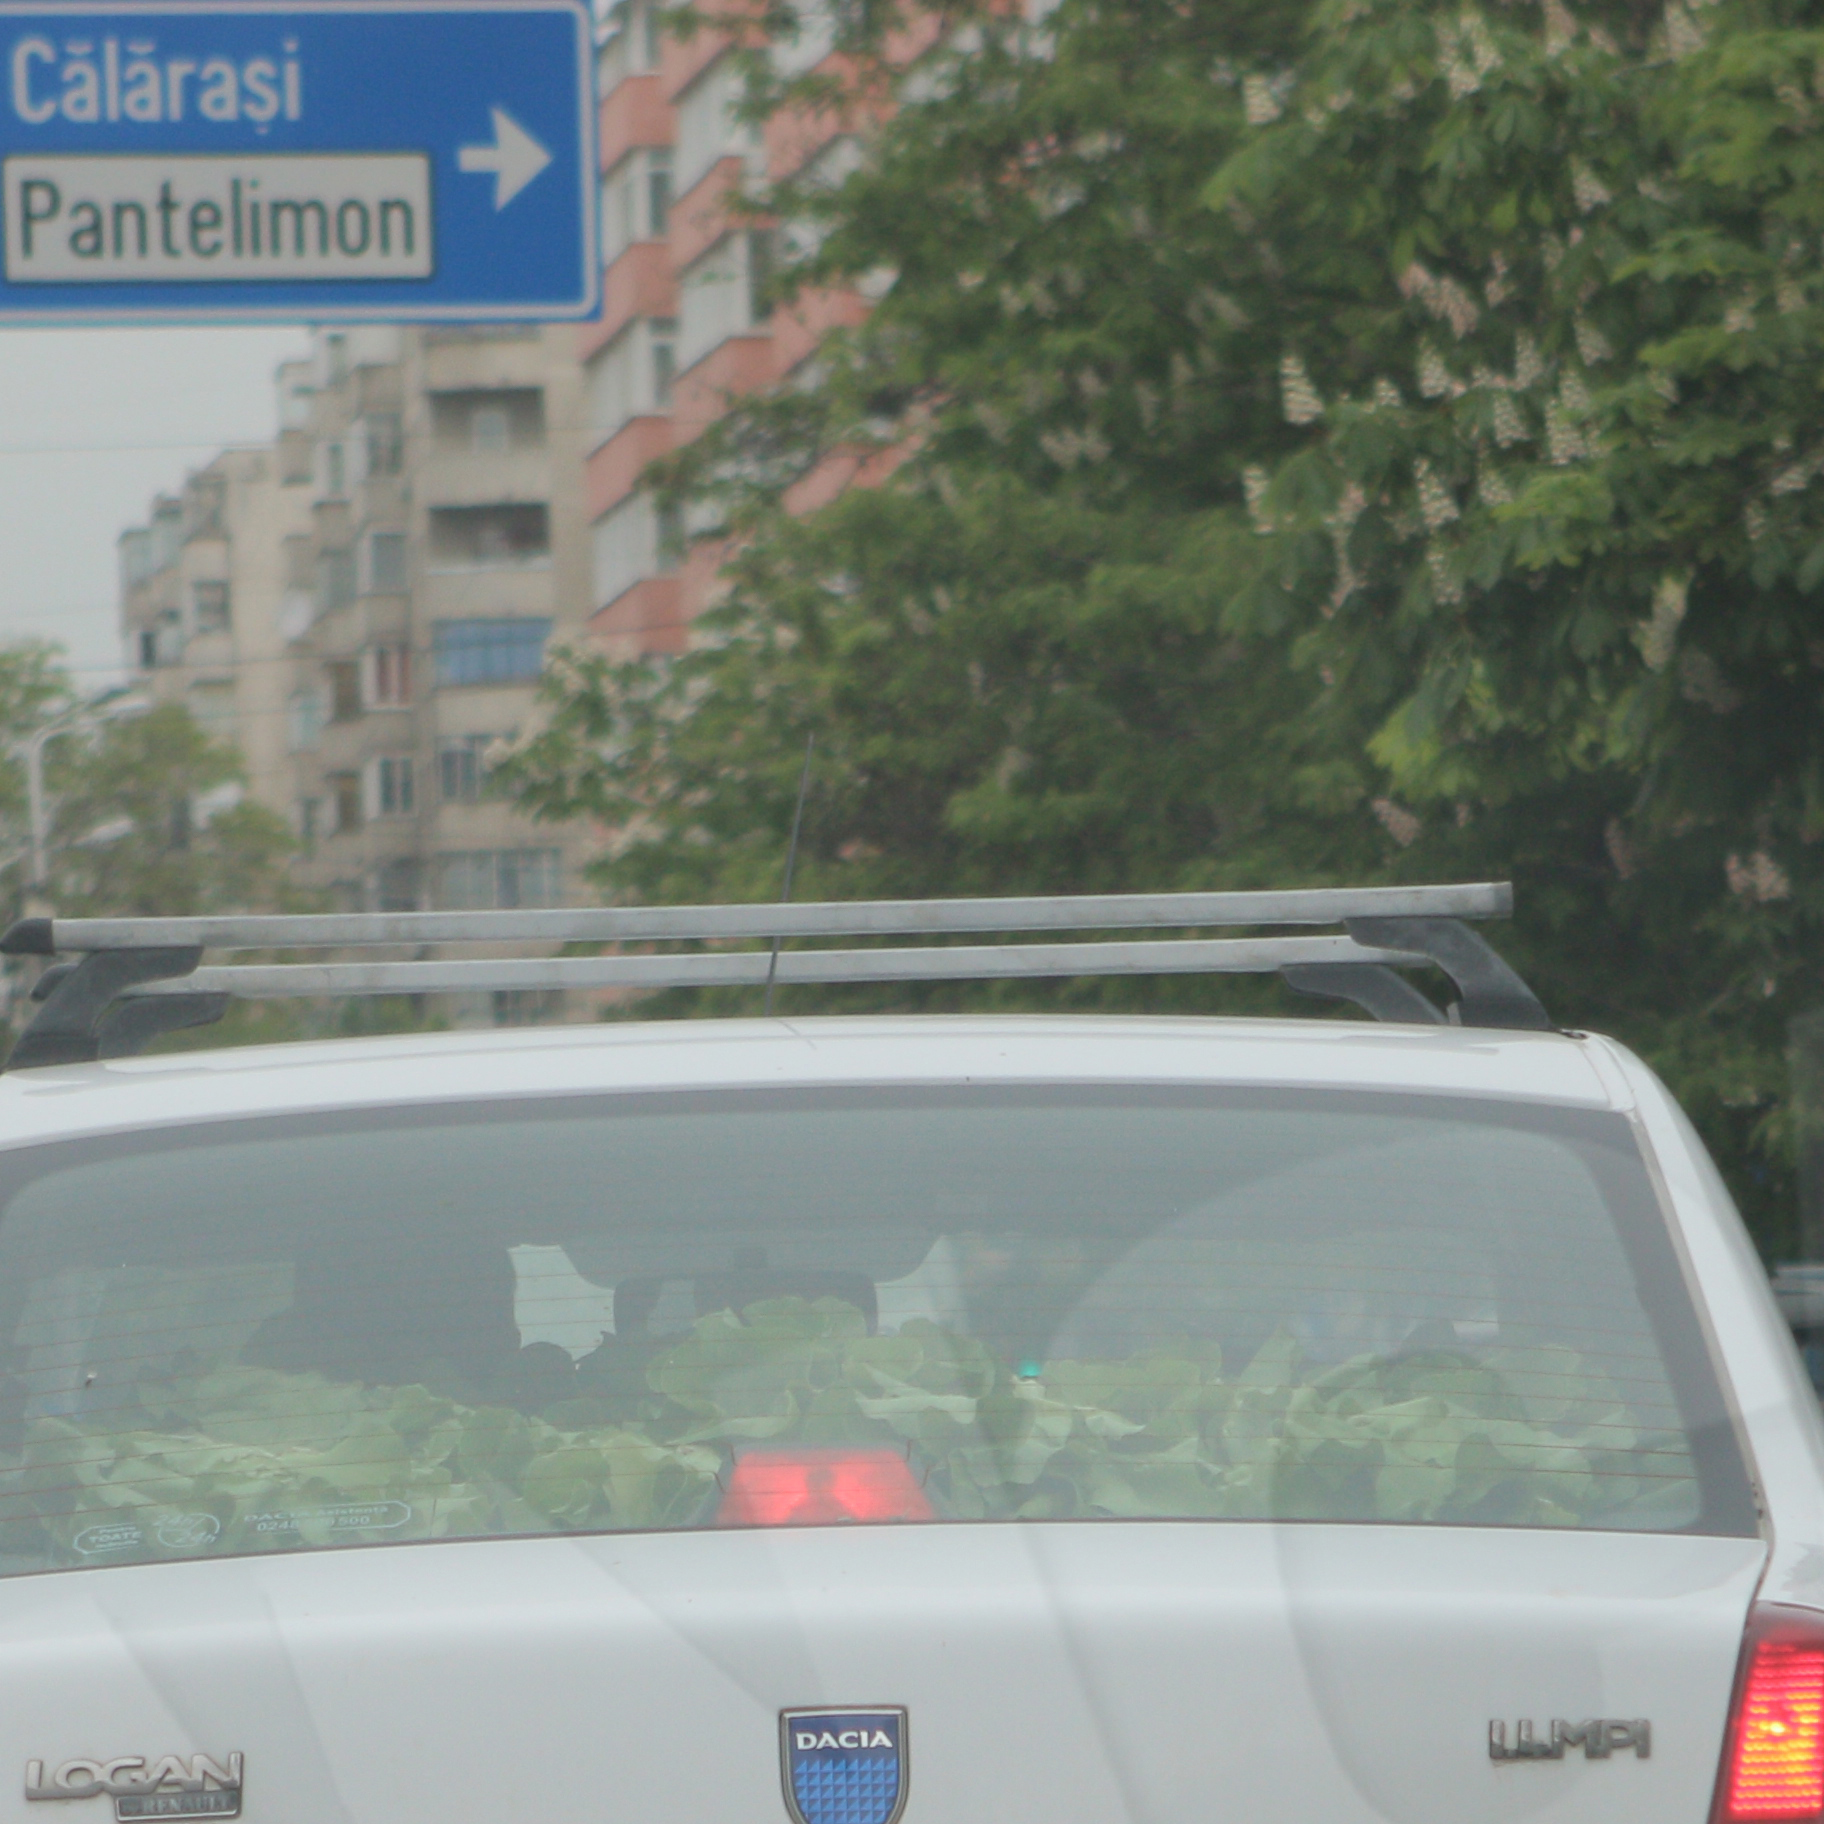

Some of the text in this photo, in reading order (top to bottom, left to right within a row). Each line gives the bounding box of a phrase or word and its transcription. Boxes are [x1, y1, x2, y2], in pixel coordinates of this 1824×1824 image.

[12, 36, 302, 134] Călărași
[20, 178, 416, 259] Pantelimon
[796, 1731, 893, 1751] DACIA
[26, 1752, 243, 1800] LOGAN
